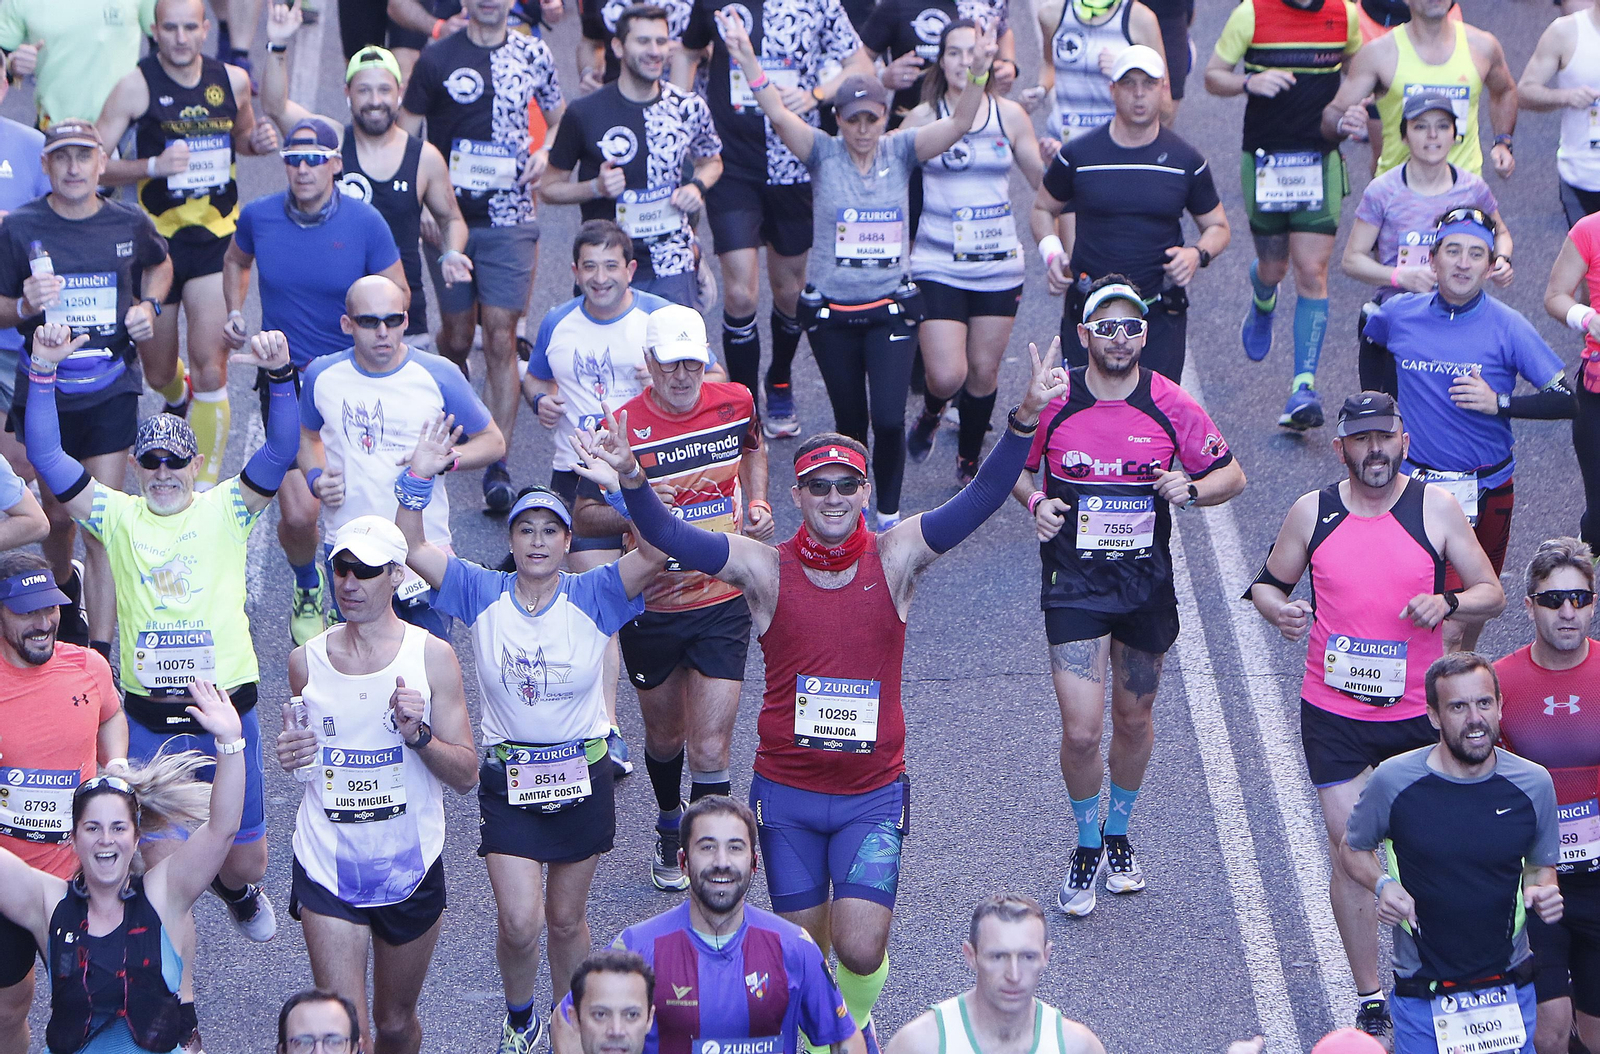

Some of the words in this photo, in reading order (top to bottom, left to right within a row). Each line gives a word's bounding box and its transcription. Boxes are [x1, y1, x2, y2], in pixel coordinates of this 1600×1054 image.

[188, 138, 224, 150] ZURICH
[473, 145, 509, 156] ZURICH
[1277, 155, 1314, 167] ZURICH
[639, 186, 672, 202] ZURICH
[859, 210, 897, 222] ZURICH
[859, 232, 885, 242] 8484
[857, 247, 885, 255] MAGMA
[67, 276, 108, 288] ZURICH
[63, 296, 97, 308] 12501
[66, 314, 97, 323] CARLOS
[1401, 359, 1461, 376] CARTAYA
[657, 433, 739, 465] PubliPrenda
[525, 498, 554, 506] 2XU
[1105, 500, 1148, 511] ZURICH
[686, 502, 725, 519] ZURICH
[1103, 523, 1134, 535] 7555
[1097, 538, 1135, 548] CHUSFLY
[21, 574, 47, 588] UTMB
[404, 580, 425, 596] JOSÉ
[145, 619, 204, 630] #Run4Fun
[160, 633, 204, 646] ZURICH
[1352, 641, 1398, 656] ZURICH
[156, 659, 195, 671] 10075
[154, 675, 196, 685] ROBERTO
[1349, 666, 1382, 680] 9440
[824, 681, 870, 696] ZURICH
[1343, 680, 1383, 694] ANTONIO
[818, 707, 858, 721] 10295
[813, 724, 857, 738] RUNJOCA
[347, 752, 393, 766] ZURICH
[534, 744, 578, 761] ZURICH
[27, 773, 73, 786] ZURICH
[347, 779, 379, 792] 9251
[535, 772, 566, 786] 8514
[518, 788, 552, 802] AMITAF
[554, 785, 583, 799] COSTA
[24, 800, 57, 813] 8793
[335, 797, 356, 808] LUIS
[357, 794, 394, 806] MIGUEL
[13, 814, 62, 829] CÁRDENAS
[1560, 832, 1579, 846] 59
[1563, 848, 1587, 860] 1976
[1460, 991, 1507, 1009] ZURICH
[1462, 1019, 1502, 1037] 10509
[723, 1040, 773, 1054] ZURICH
[1478, 1034, 1521, 1050] MONICHE
